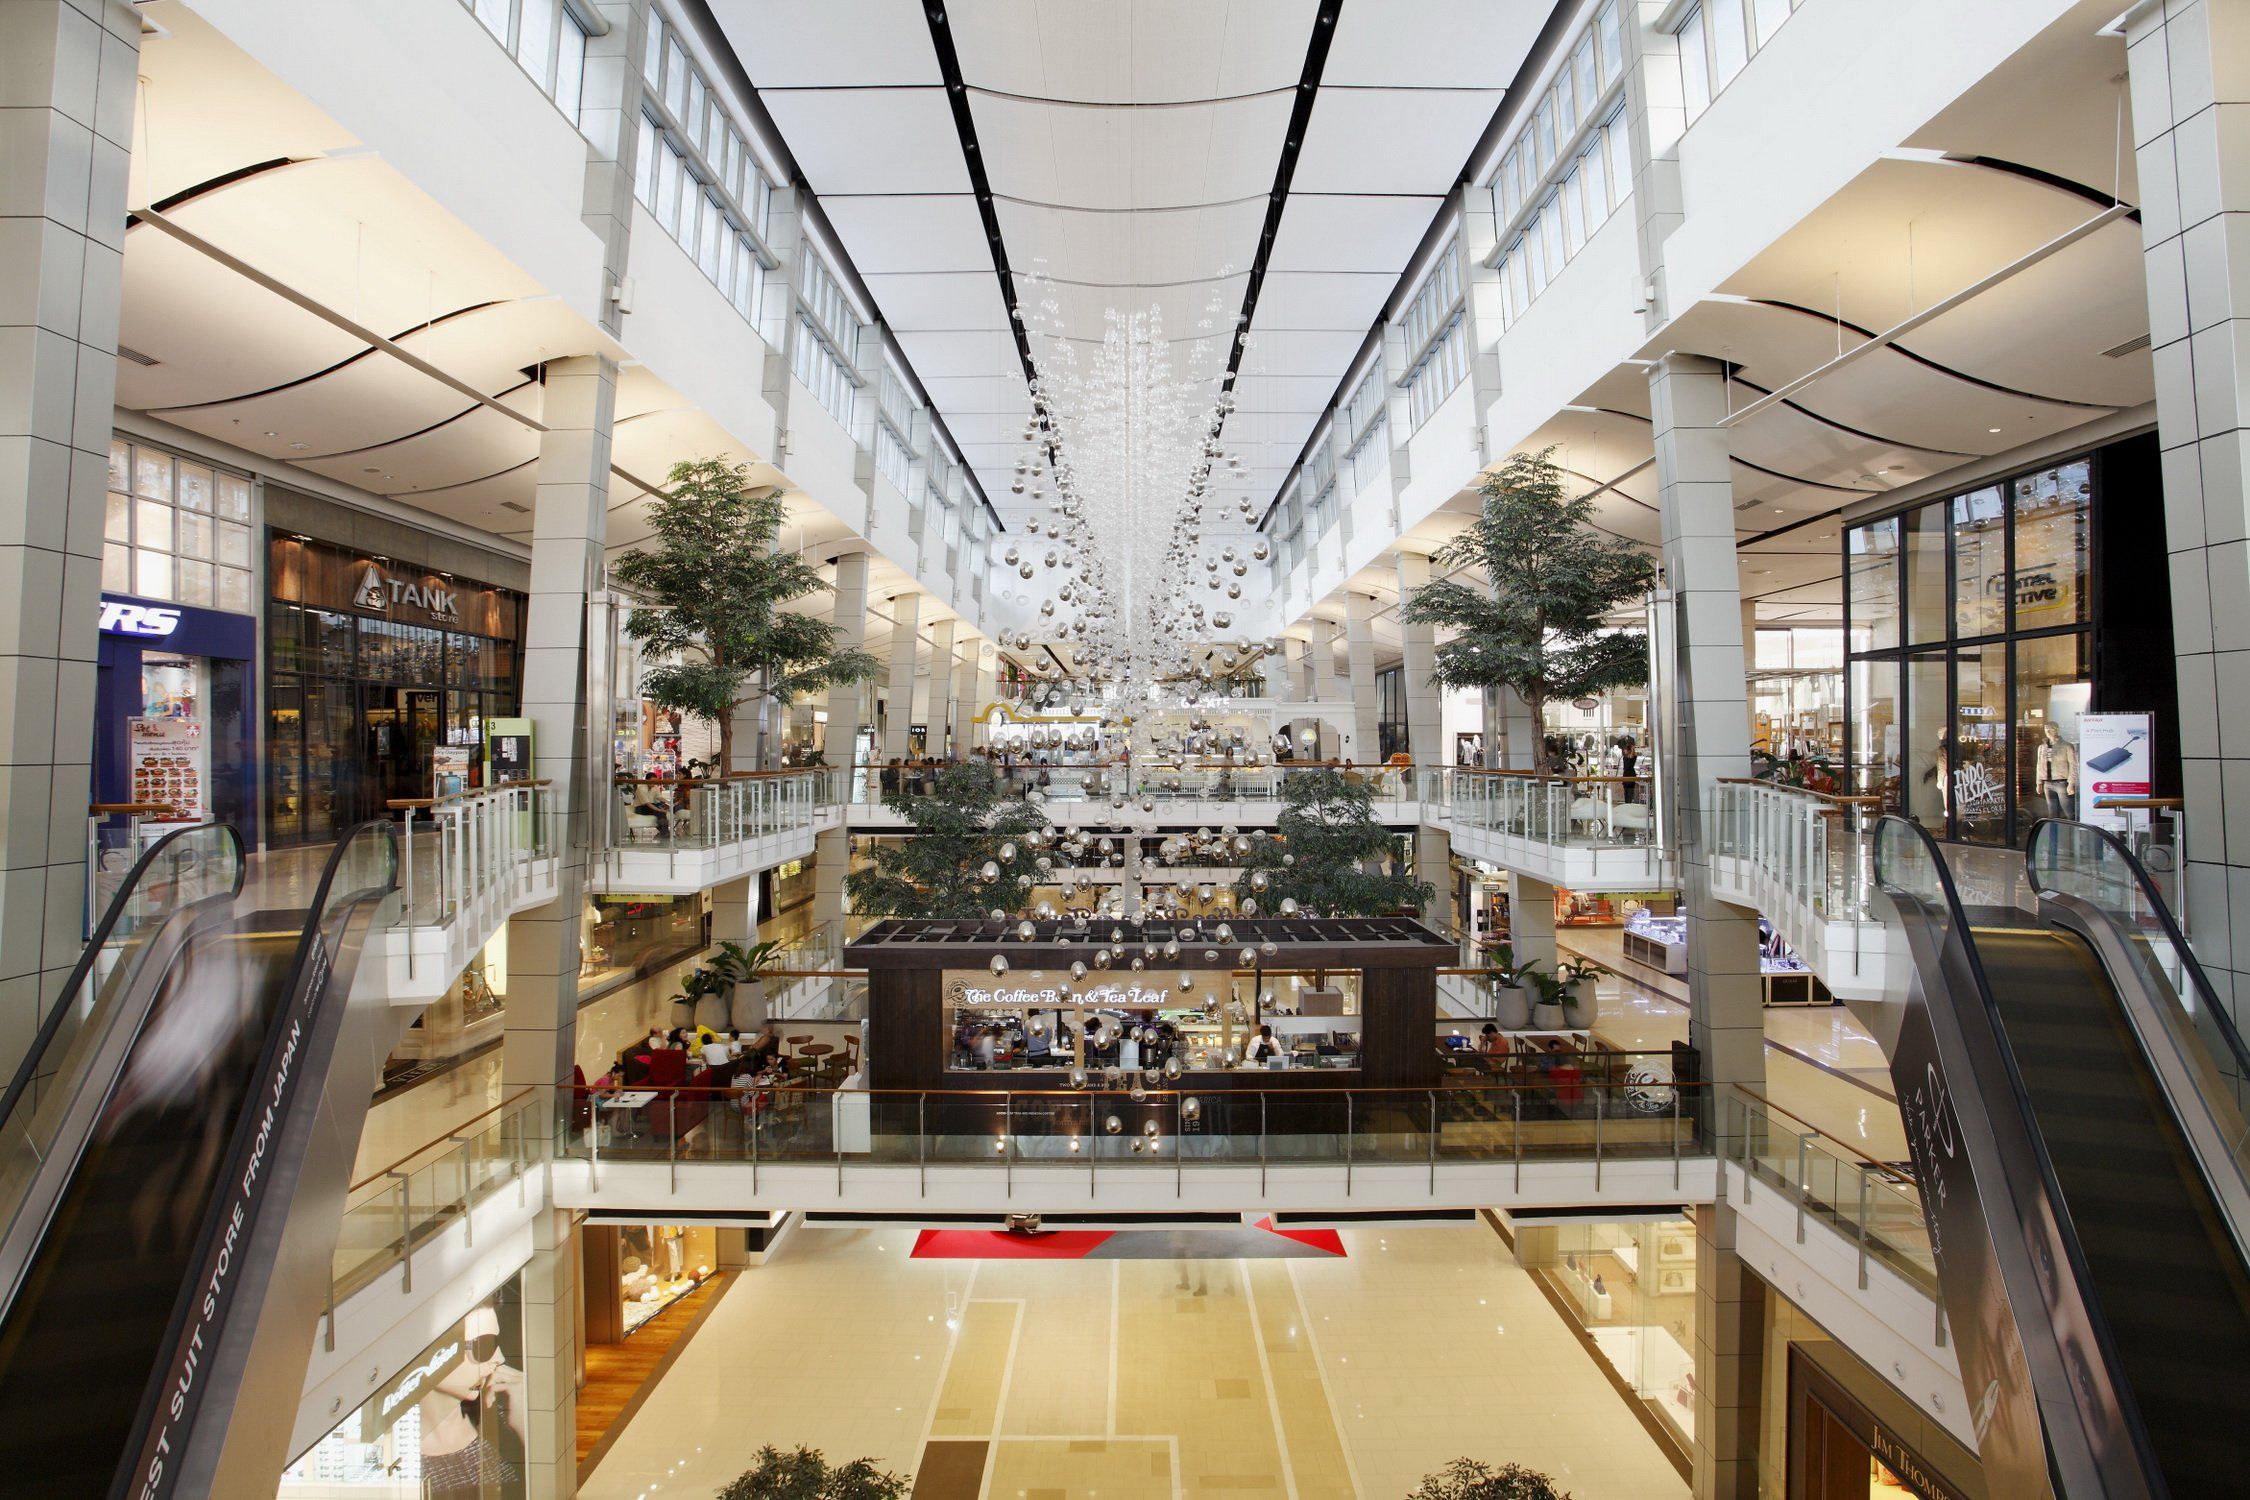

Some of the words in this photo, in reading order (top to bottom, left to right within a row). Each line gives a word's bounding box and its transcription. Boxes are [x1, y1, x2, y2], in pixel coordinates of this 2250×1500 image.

[385, 578, 459, 616] TANK
[99, 602, 181, 635] RS
[430, 611, 459, 624] store
[491, 721, 497, 731] 3
[1953, 762, 1985, 789] INDO
[965, 986, 991, 1005] The
[993, 988, 1039, 1004] Coffee
[1085, 989, 1099, 1004] &
[1099, 987, 1127, 1004] Tea
[1127, 987, 1169, 1004] Leaf
[1915, 1086, 1948, 1209] PARKER
[171, 1323, 204, 1422] SUIT
[203, 1200, 244, 1322] STORE
[243, 1105, 274, 1198] FROM
[273, 1018, 301, 1108] JAPAN
[1871, 1424, 1893, 1460] JIM
[1896, 1444, 1952, 1500] THOMP
